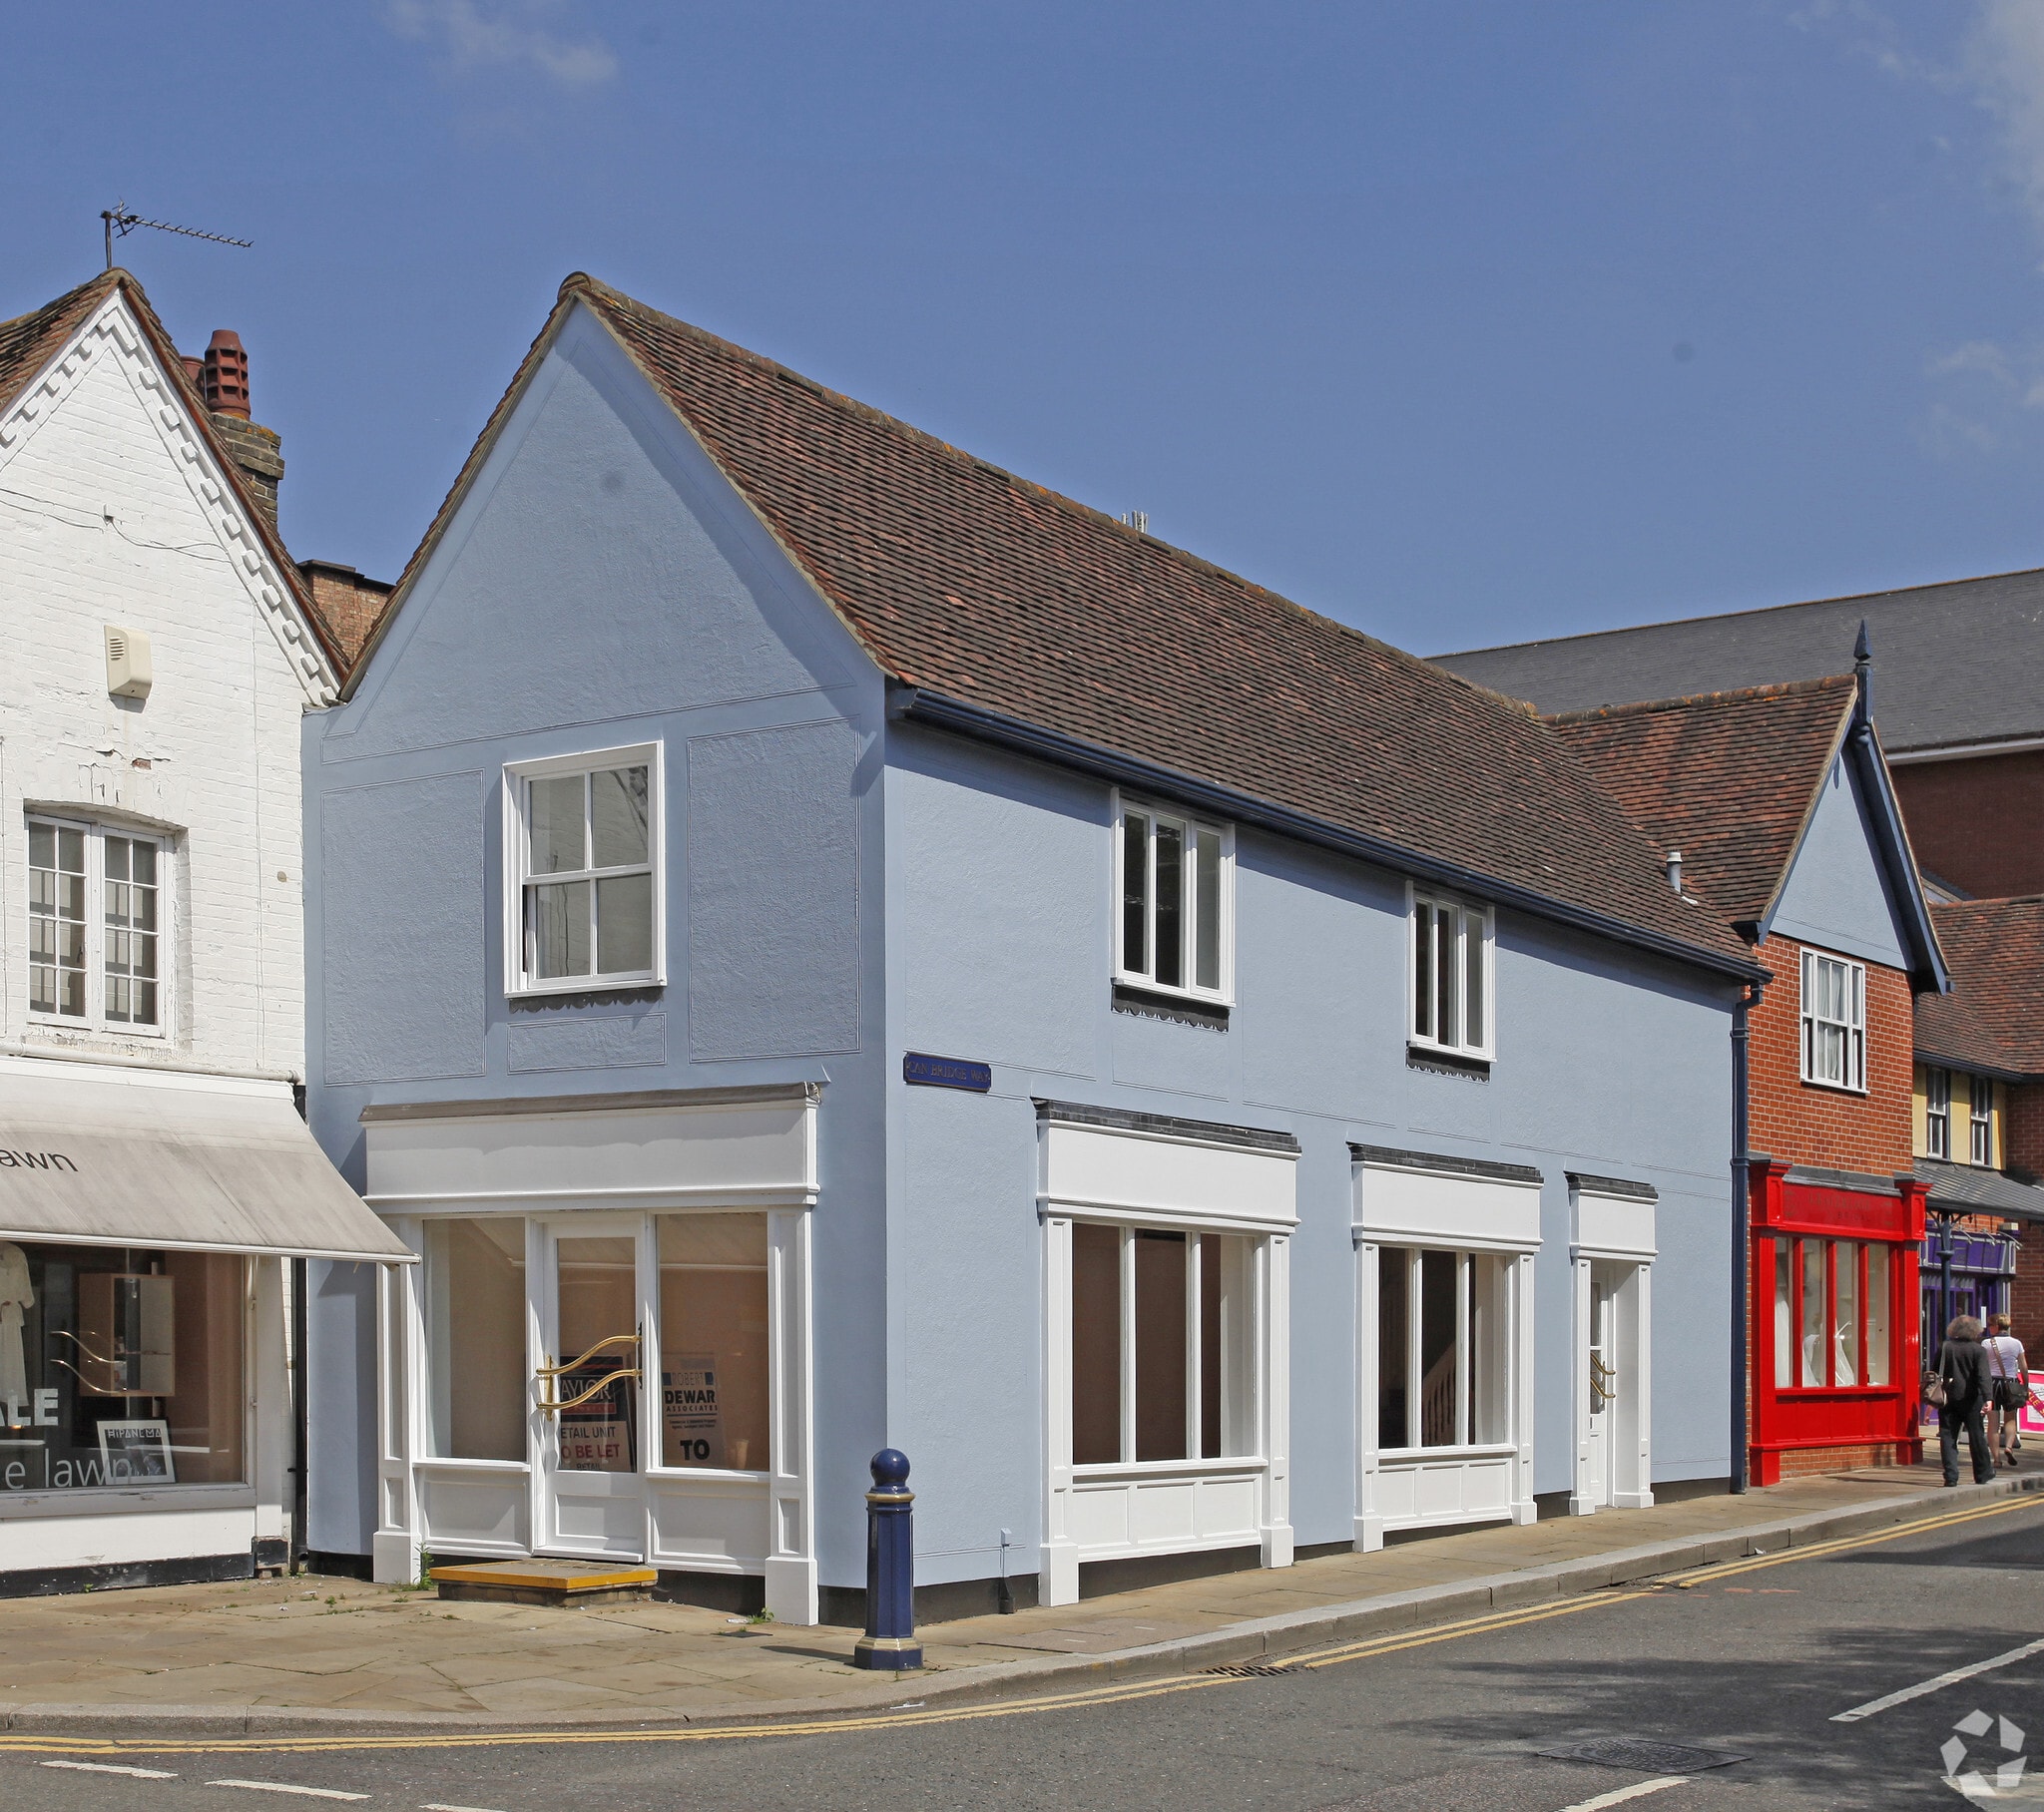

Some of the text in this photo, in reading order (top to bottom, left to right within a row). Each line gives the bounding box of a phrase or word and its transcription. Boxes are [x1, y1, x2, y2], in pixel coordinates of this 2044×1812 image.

[930, 1064, 967, 1081] BRIDGE
[971, 1070, 989, 1083] WAY
[0, 1149, 79, 1172] awn
[672, 1372, 704, 1386] ROBERT
[561, 1379, 612, 1400] AYLOR
[664, 1390, 716, 1405] DEWAR
[0, 1389, 59, 1426] LE
[561, 1426, 616, 1439] ETAIL UNIT
[561, 1444, 620, 1460] O BE LET
[680, 1439, 710, 1460] TO
[45, 1448, 133, 1488] lawn
